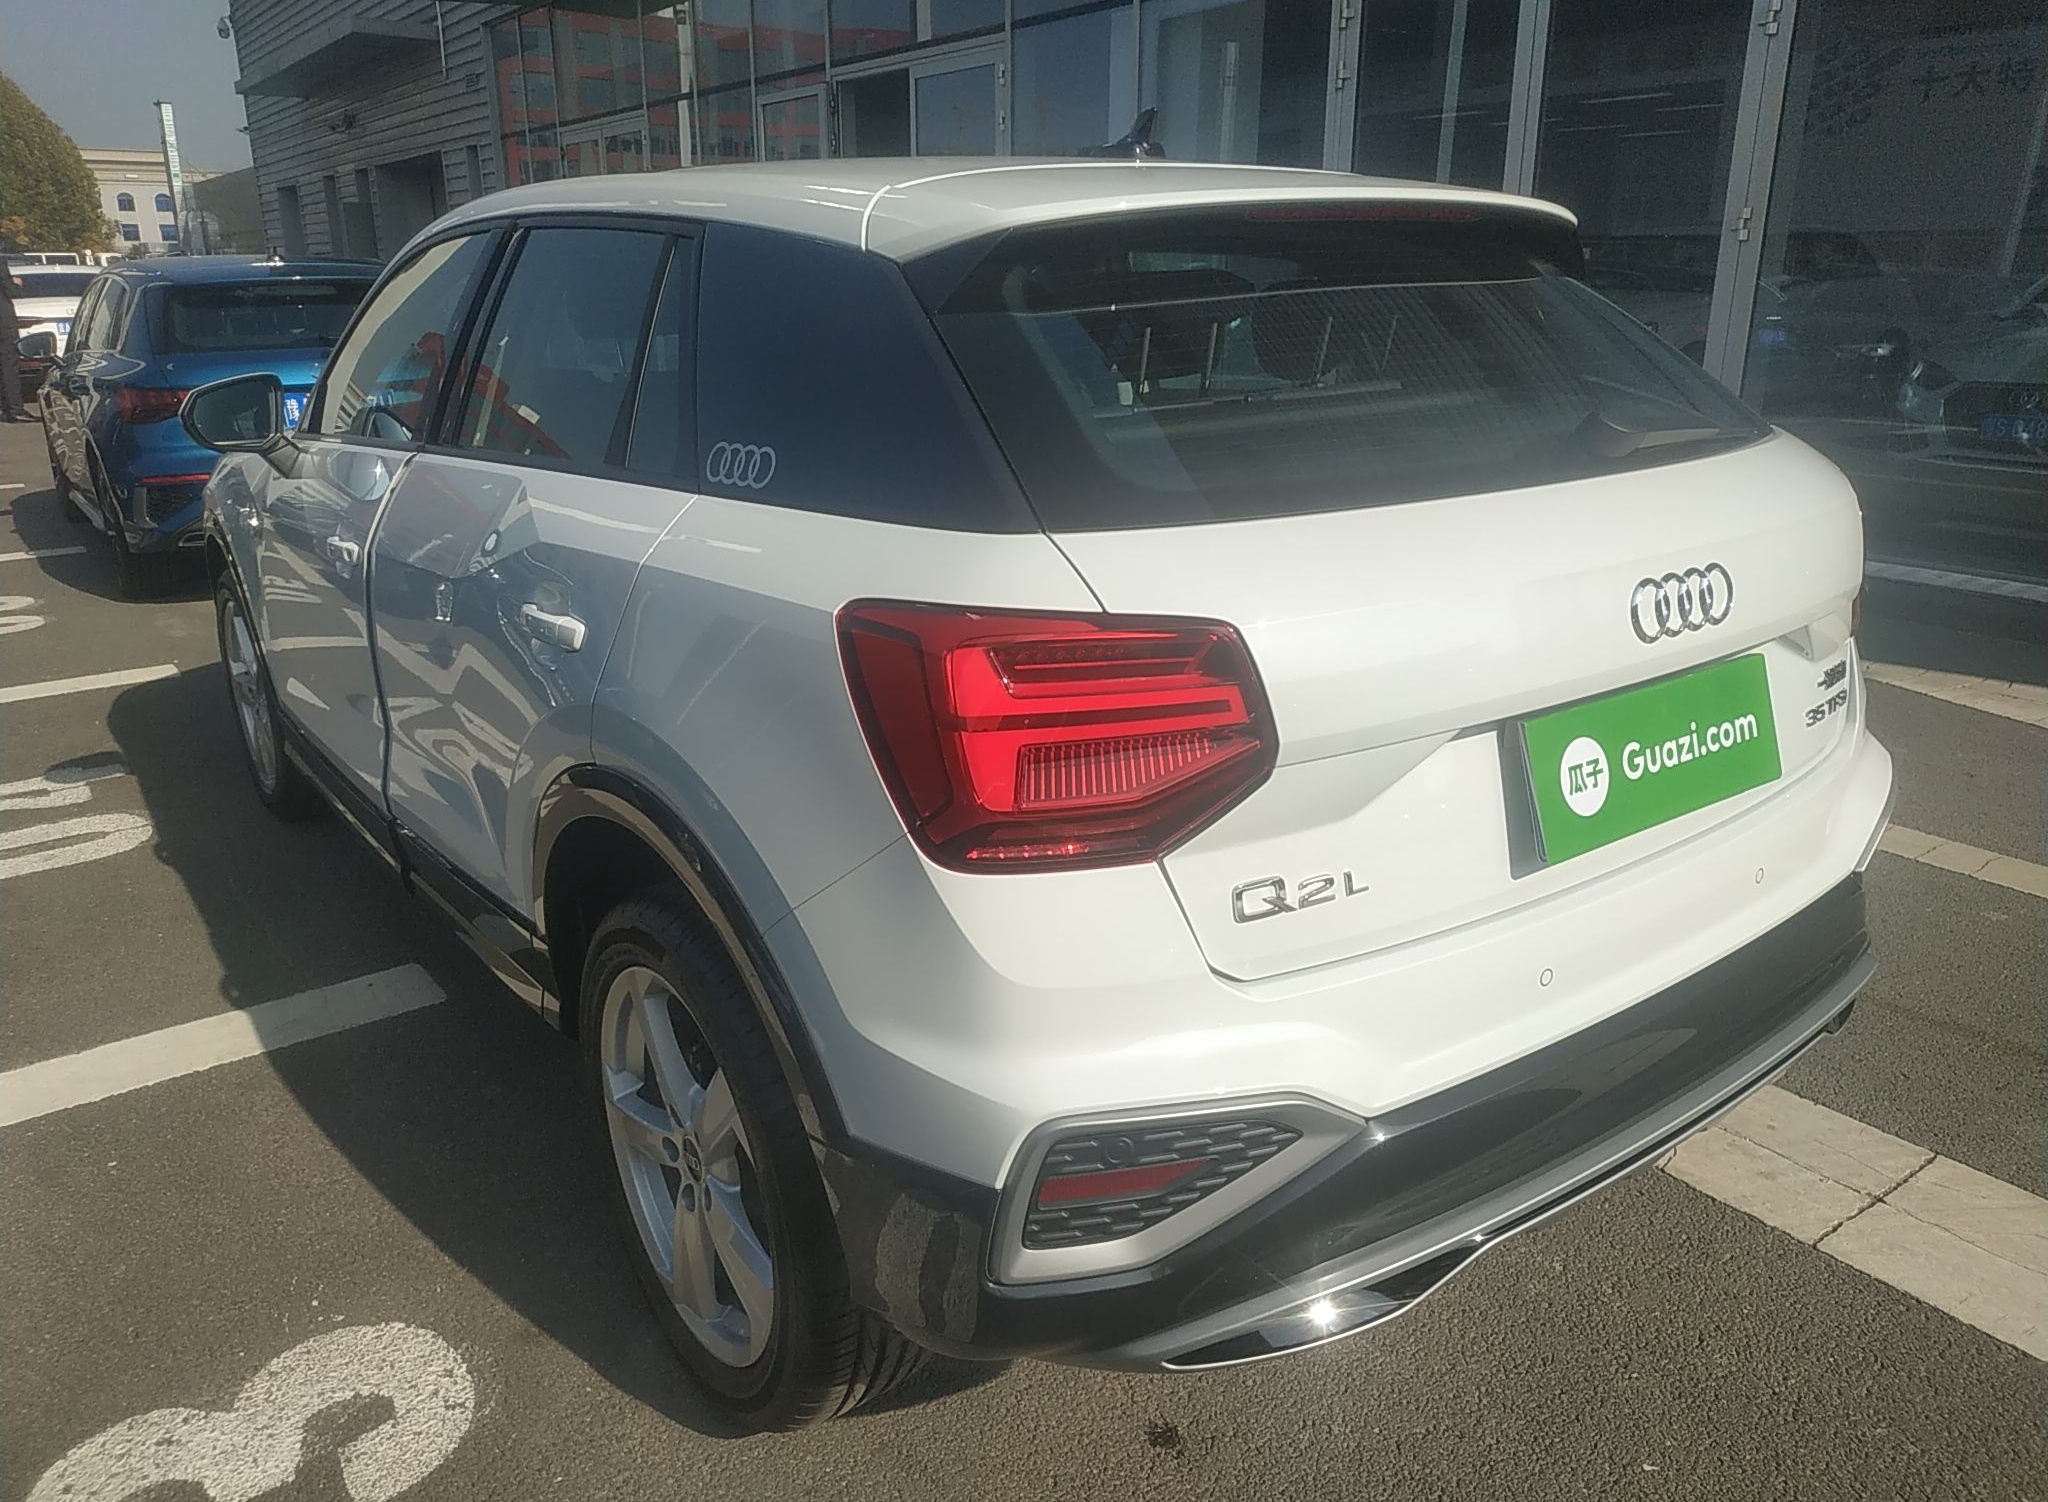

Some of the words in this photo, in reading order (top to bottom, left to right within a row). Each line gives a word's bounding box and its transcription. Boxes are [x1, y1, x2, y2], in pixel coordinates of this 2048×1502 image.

[1804, 703, 1826, 728] 35
[1622, 712, 1759, 781] Guazi.com
[1566, 757, 1605, 797] 瓜子
[1231, 870, 1370, 924] Q2L
